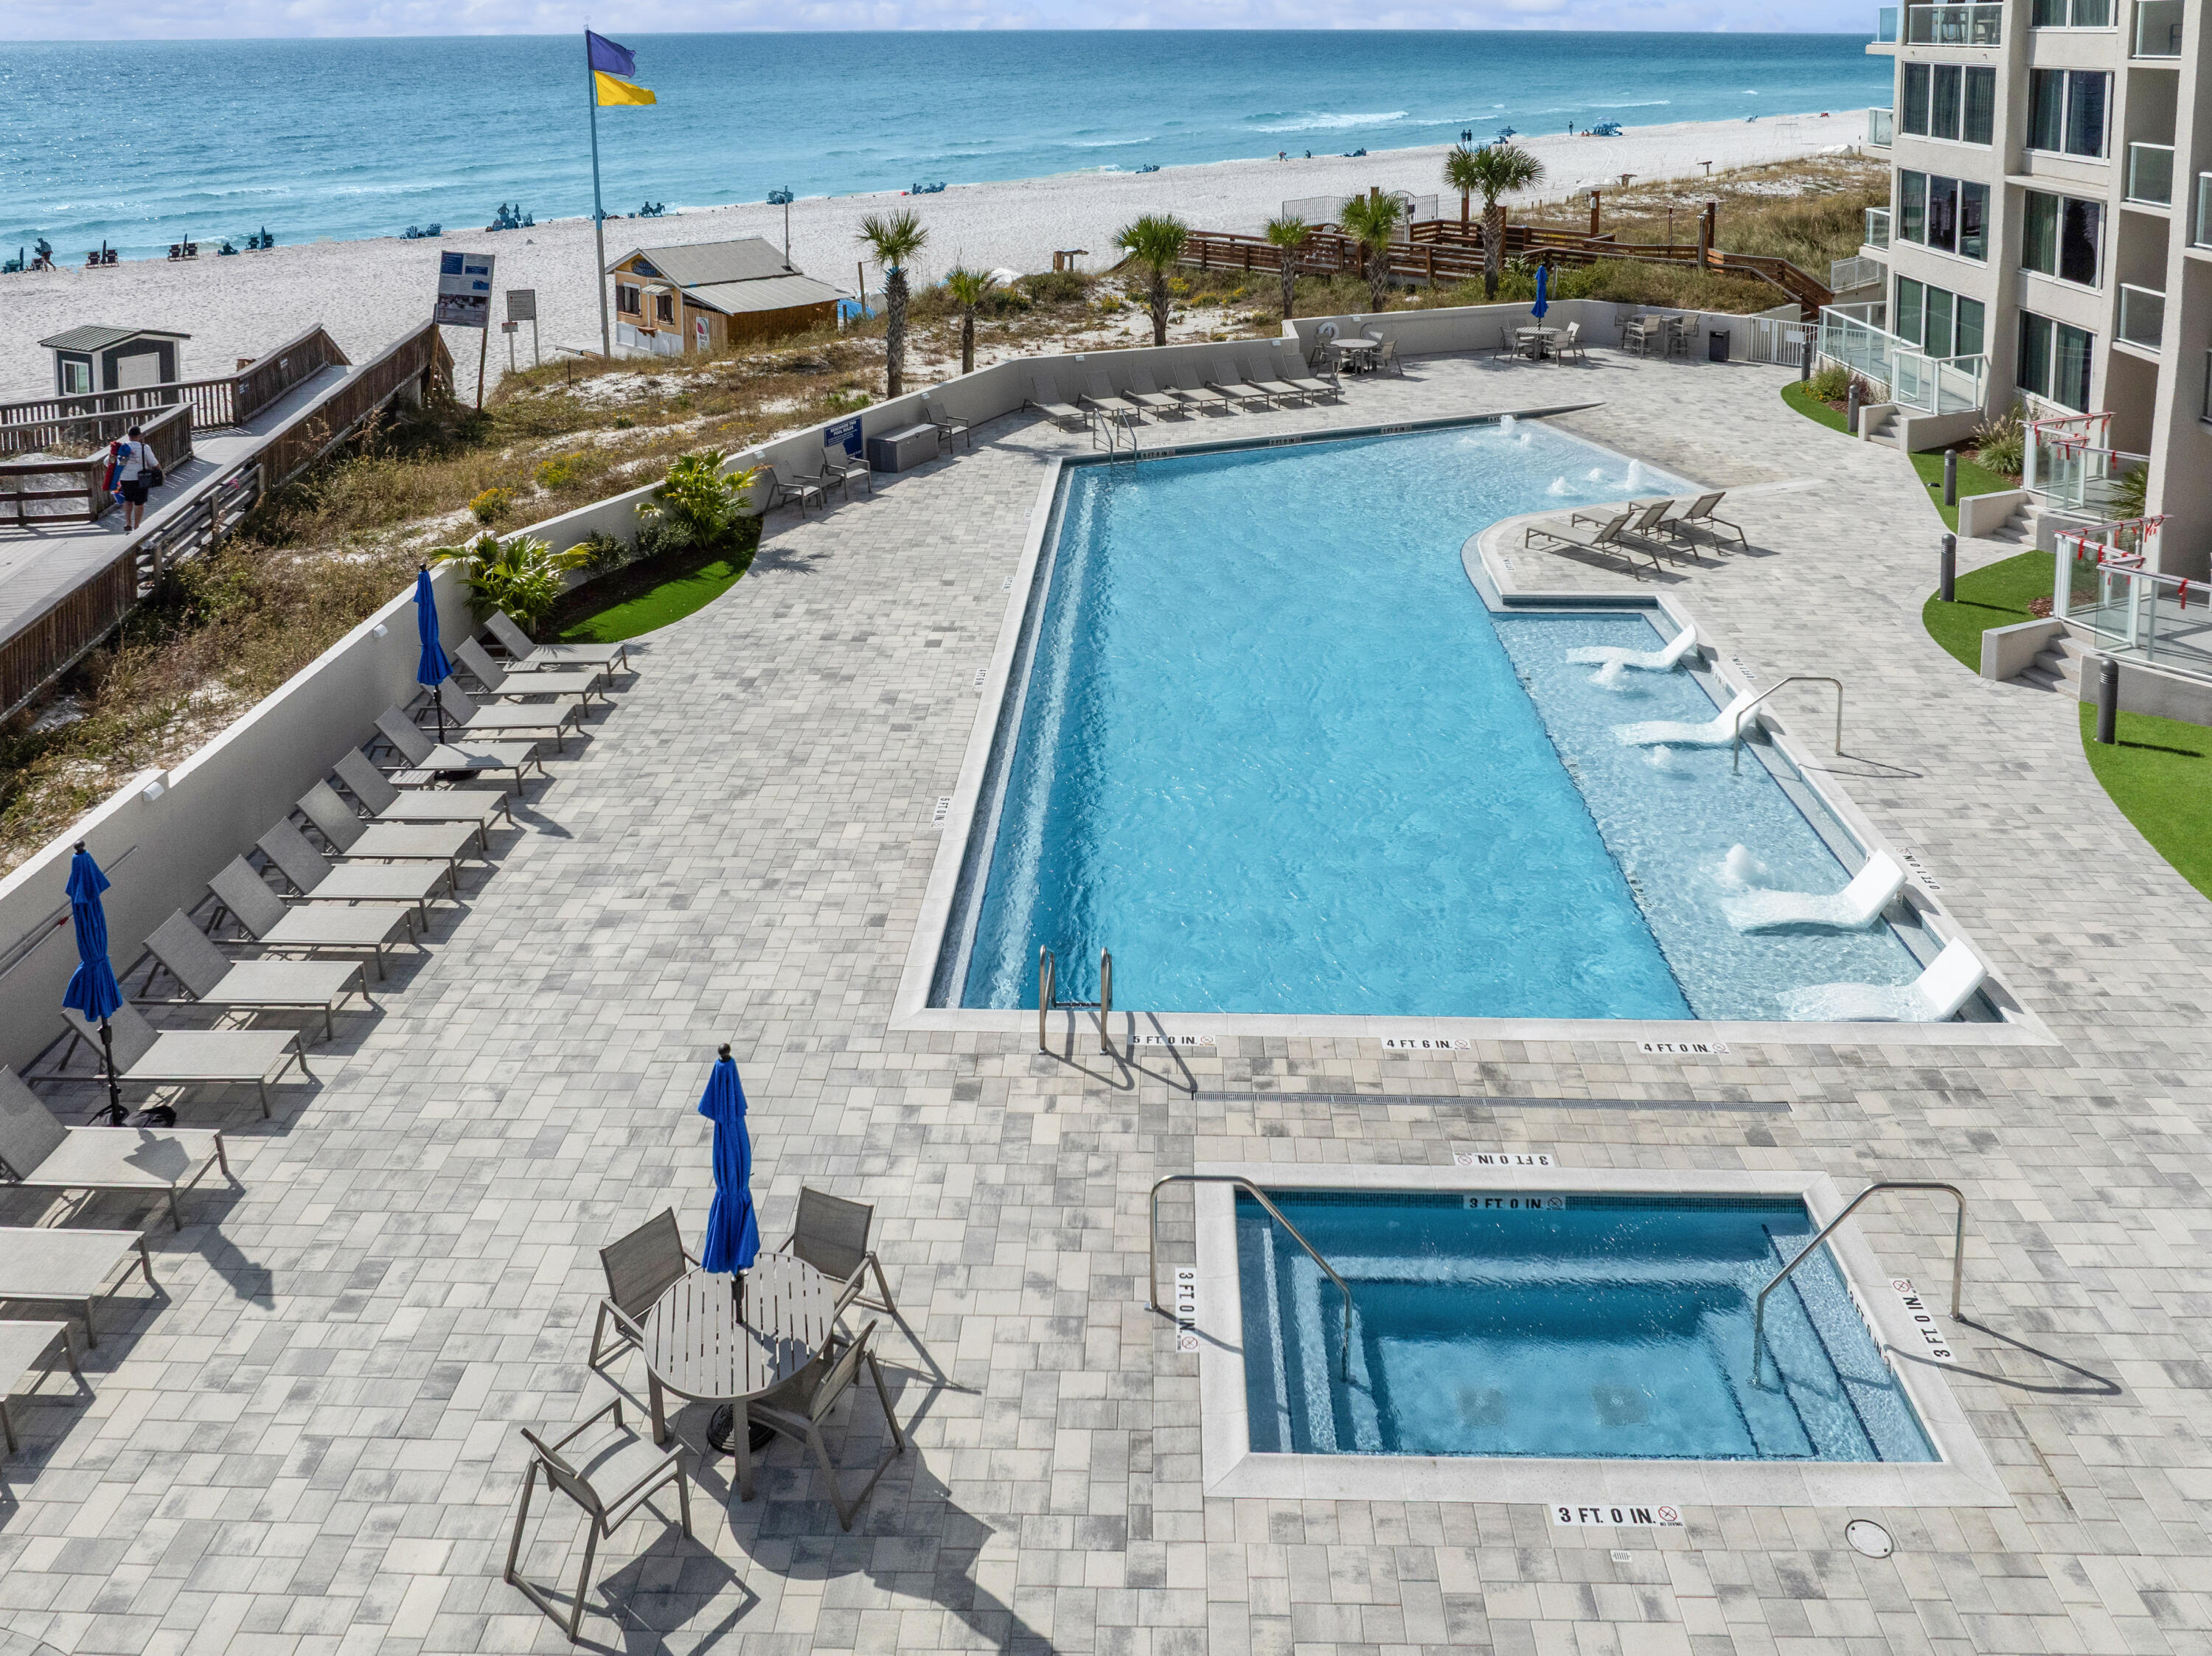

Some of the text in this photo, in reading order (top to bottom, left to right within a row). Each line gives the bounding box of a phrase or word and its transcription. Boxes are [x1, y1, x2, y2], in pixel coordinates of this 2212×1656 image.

[1133, 1035, 1197, 1045] 5 FT. 0 IN.
[1387, 1040, 1394, 1048] 4
[1422, 1040, 1430, 1048] 6
[1435, 1040, 1453, 1048] IN.
[1644, 1043, 1652, 1052] 4
[1679, 1043, 1688, 1052] 0
[1500, 1155, 1509, 1165] 0
[1539, 1155, 1549, 1165] 3
[1470, 1197, 1478, 1208] 3
[1510, 1198, 1519, 1209] 0
[1933, 1349, 1951, 1357] 3
[1558, 1507, 1656, 1524] 3 FT. 0 IN.
